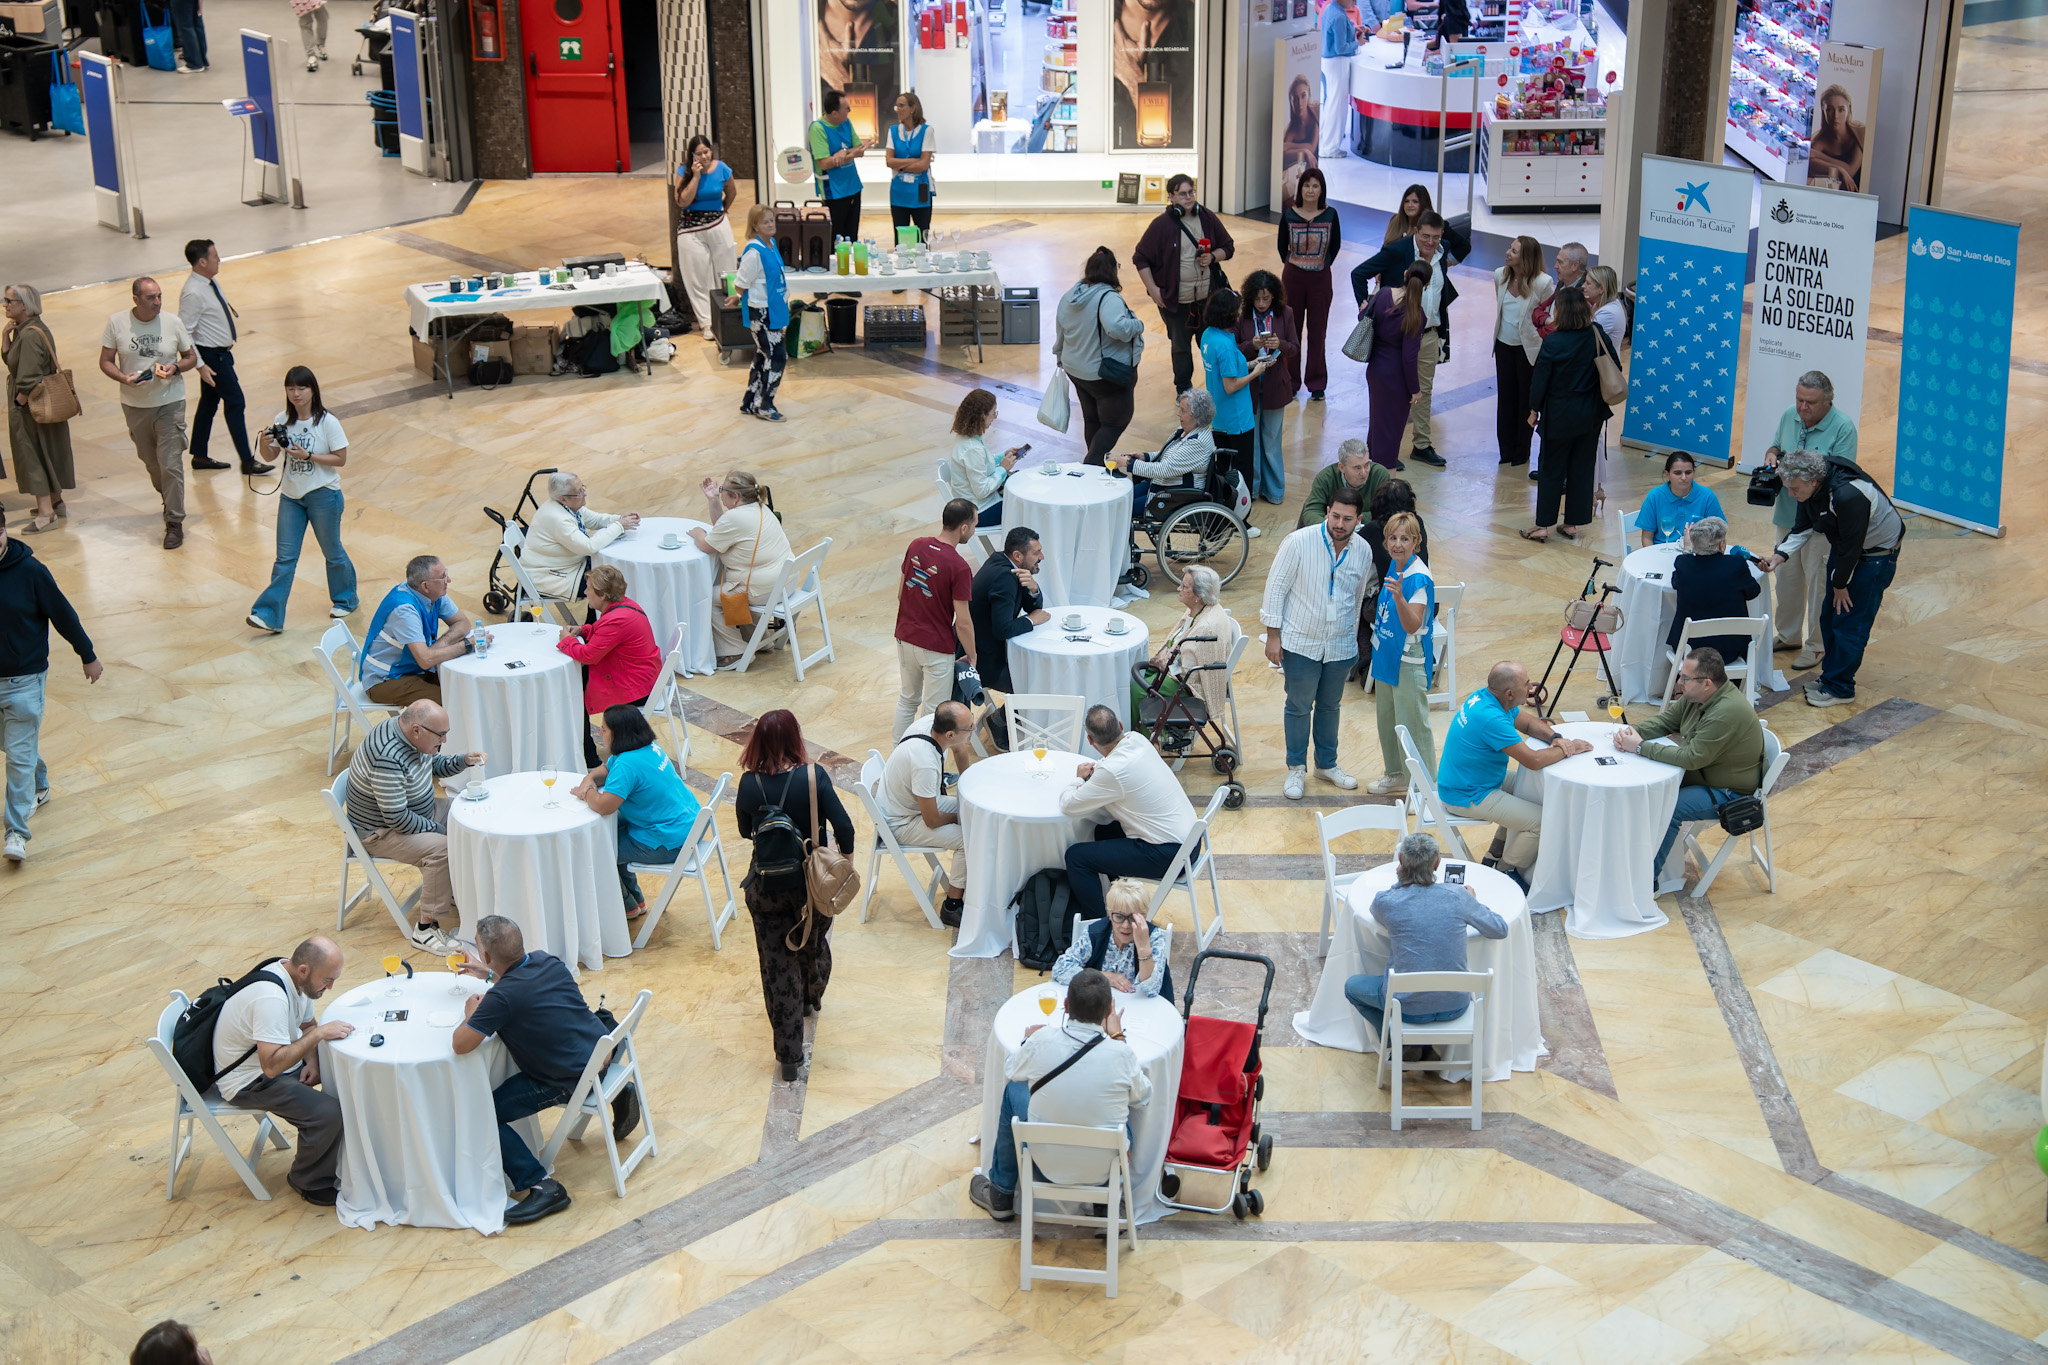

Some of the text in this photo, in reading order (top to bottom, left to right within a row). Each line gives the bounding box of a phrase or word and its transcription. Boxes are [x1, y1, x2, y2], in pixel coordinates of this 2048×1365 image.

[1827, 52, 1864, 67] MaxMara
[1650, 211, 1736, 234] Fundación "la Caixa"
[1831, 222, 1844, 230] Dios
[1767, 240, 1829, 269] SEMANA
[1931, 245, 2011, 266] SJD San Juan de Dios
[1765, 262, 1823, 290] CONTRA
[1763, 284, 1855, 317] LA SOLEDAD
[1761, 305, 1854, 341] NO DESEADA
